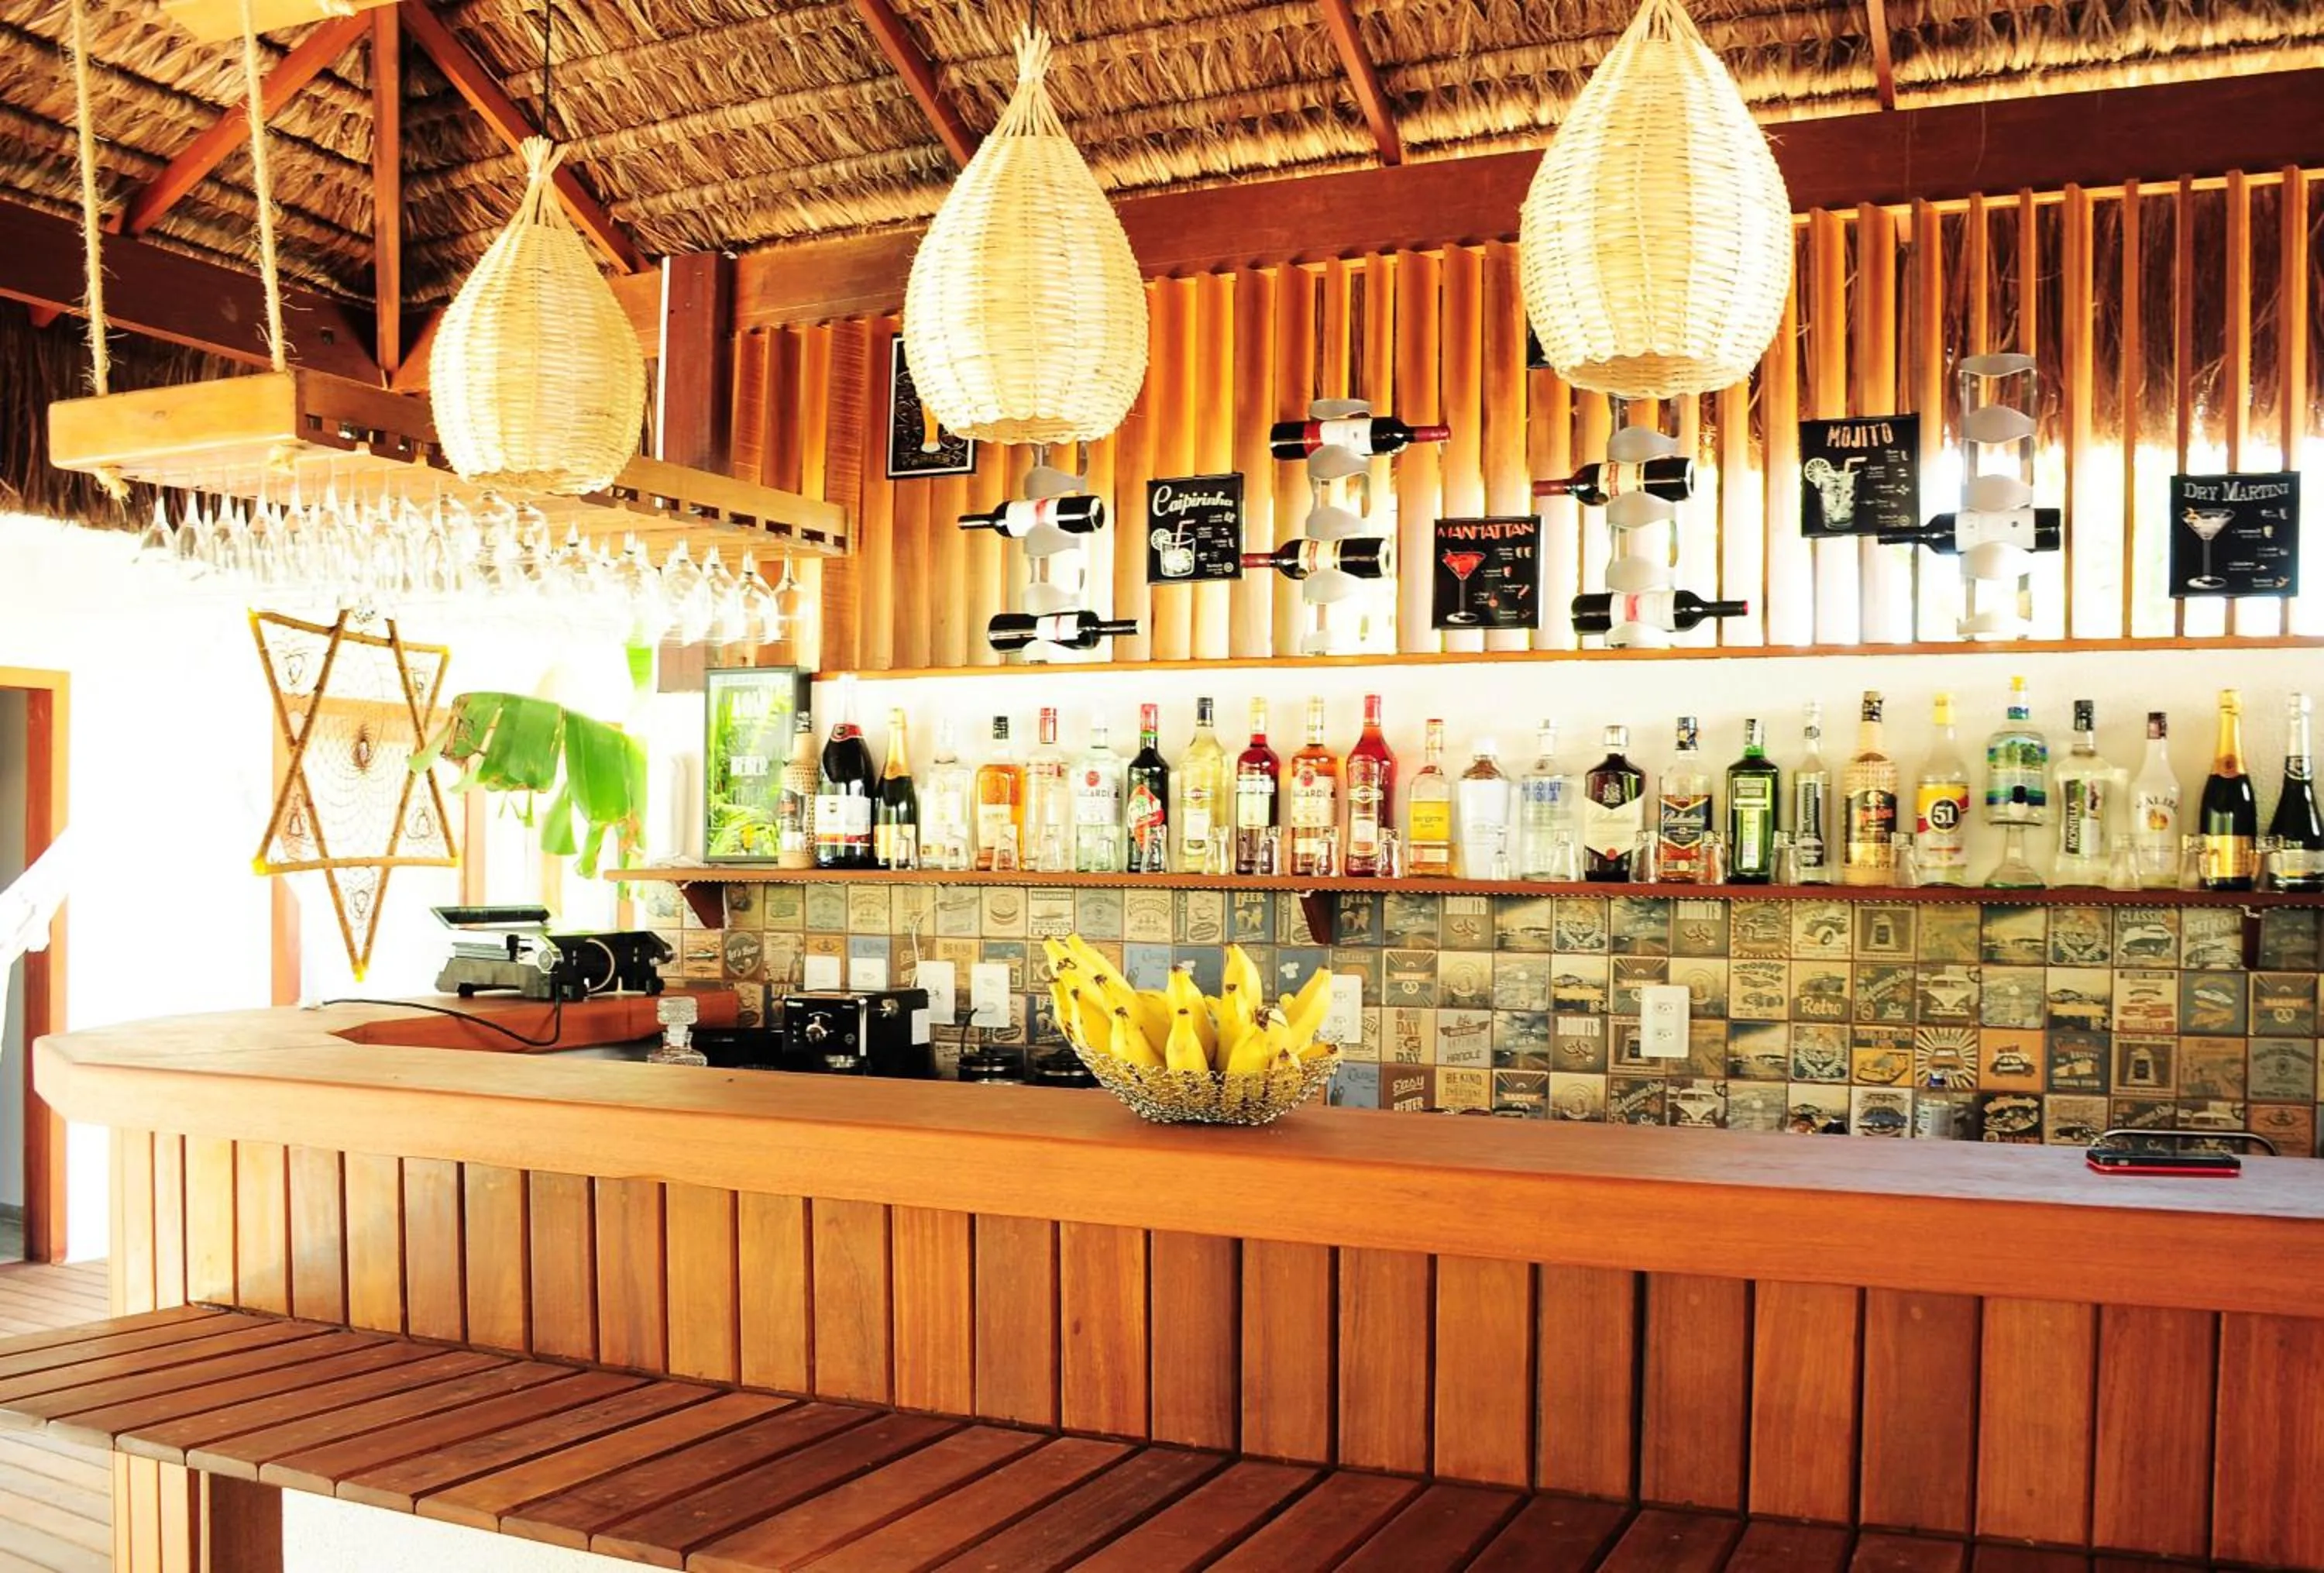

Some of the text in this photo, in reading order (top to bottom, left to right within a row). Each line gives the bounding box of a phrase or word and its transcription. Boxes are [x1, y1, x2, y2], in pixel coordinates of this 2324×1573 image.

[1827, 422, 1894, 448] MOJITO
[1152, 485, 1234, 516] Caipirinha
[2184, 481, 2289, 501] DRY MARTINI
[1437, 523, 1535, 540] MANHATTAN
[1933, 805, 1954, 824] 51
[2068, 800, 2080, 849] MONTILLA
[1800, 996, 1842, 1015] Retro
[1396, 1021, 1420, 1035] DAY
